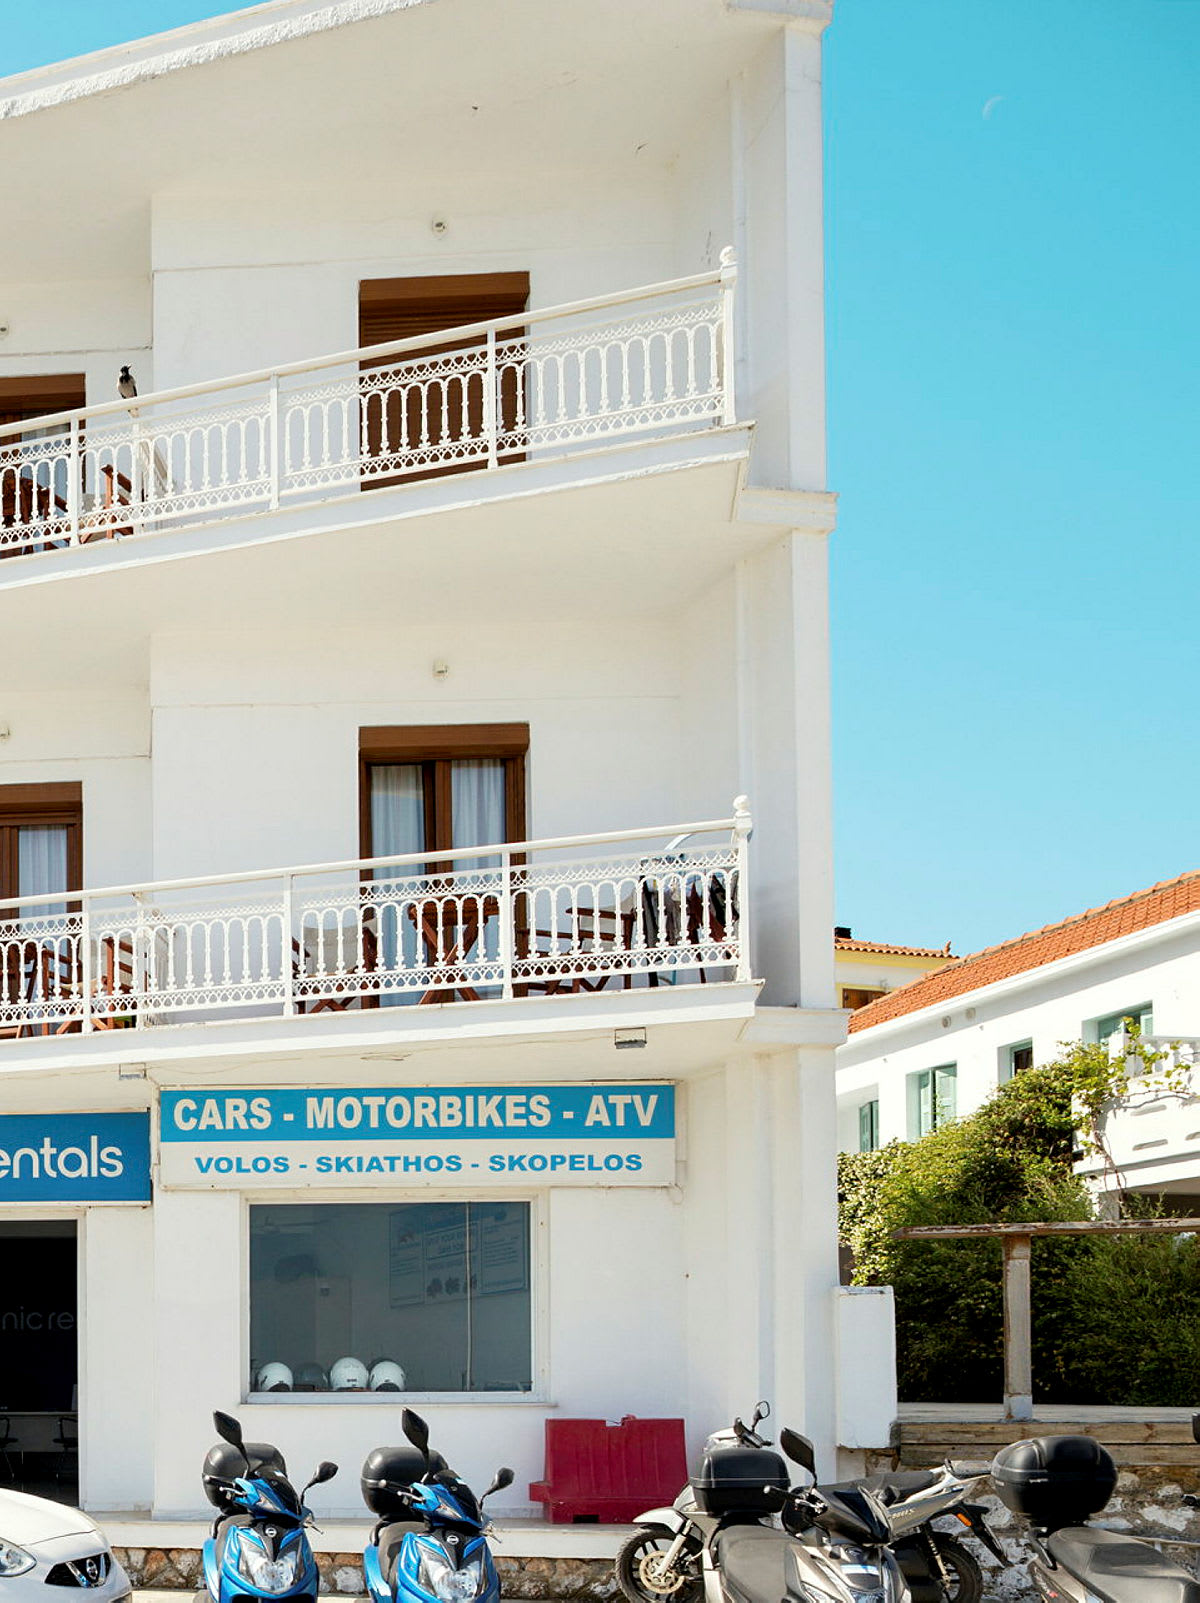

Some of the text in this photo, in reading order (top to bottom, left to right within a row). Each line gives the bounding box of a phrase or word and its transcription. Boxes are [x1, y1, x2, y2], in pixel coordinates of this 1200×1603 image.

[173, 1098, 272, 1131] CARS
[306, 1095, 551, 1129] MOTORBIKES
[584, 1094, 659, 1127] ATV
[195, 1156, 290, 1173] VOLOS
[316, 1155, 462, 1173] SKIATHOS
[489, 1154, 643, 1172] SKOPELOS
